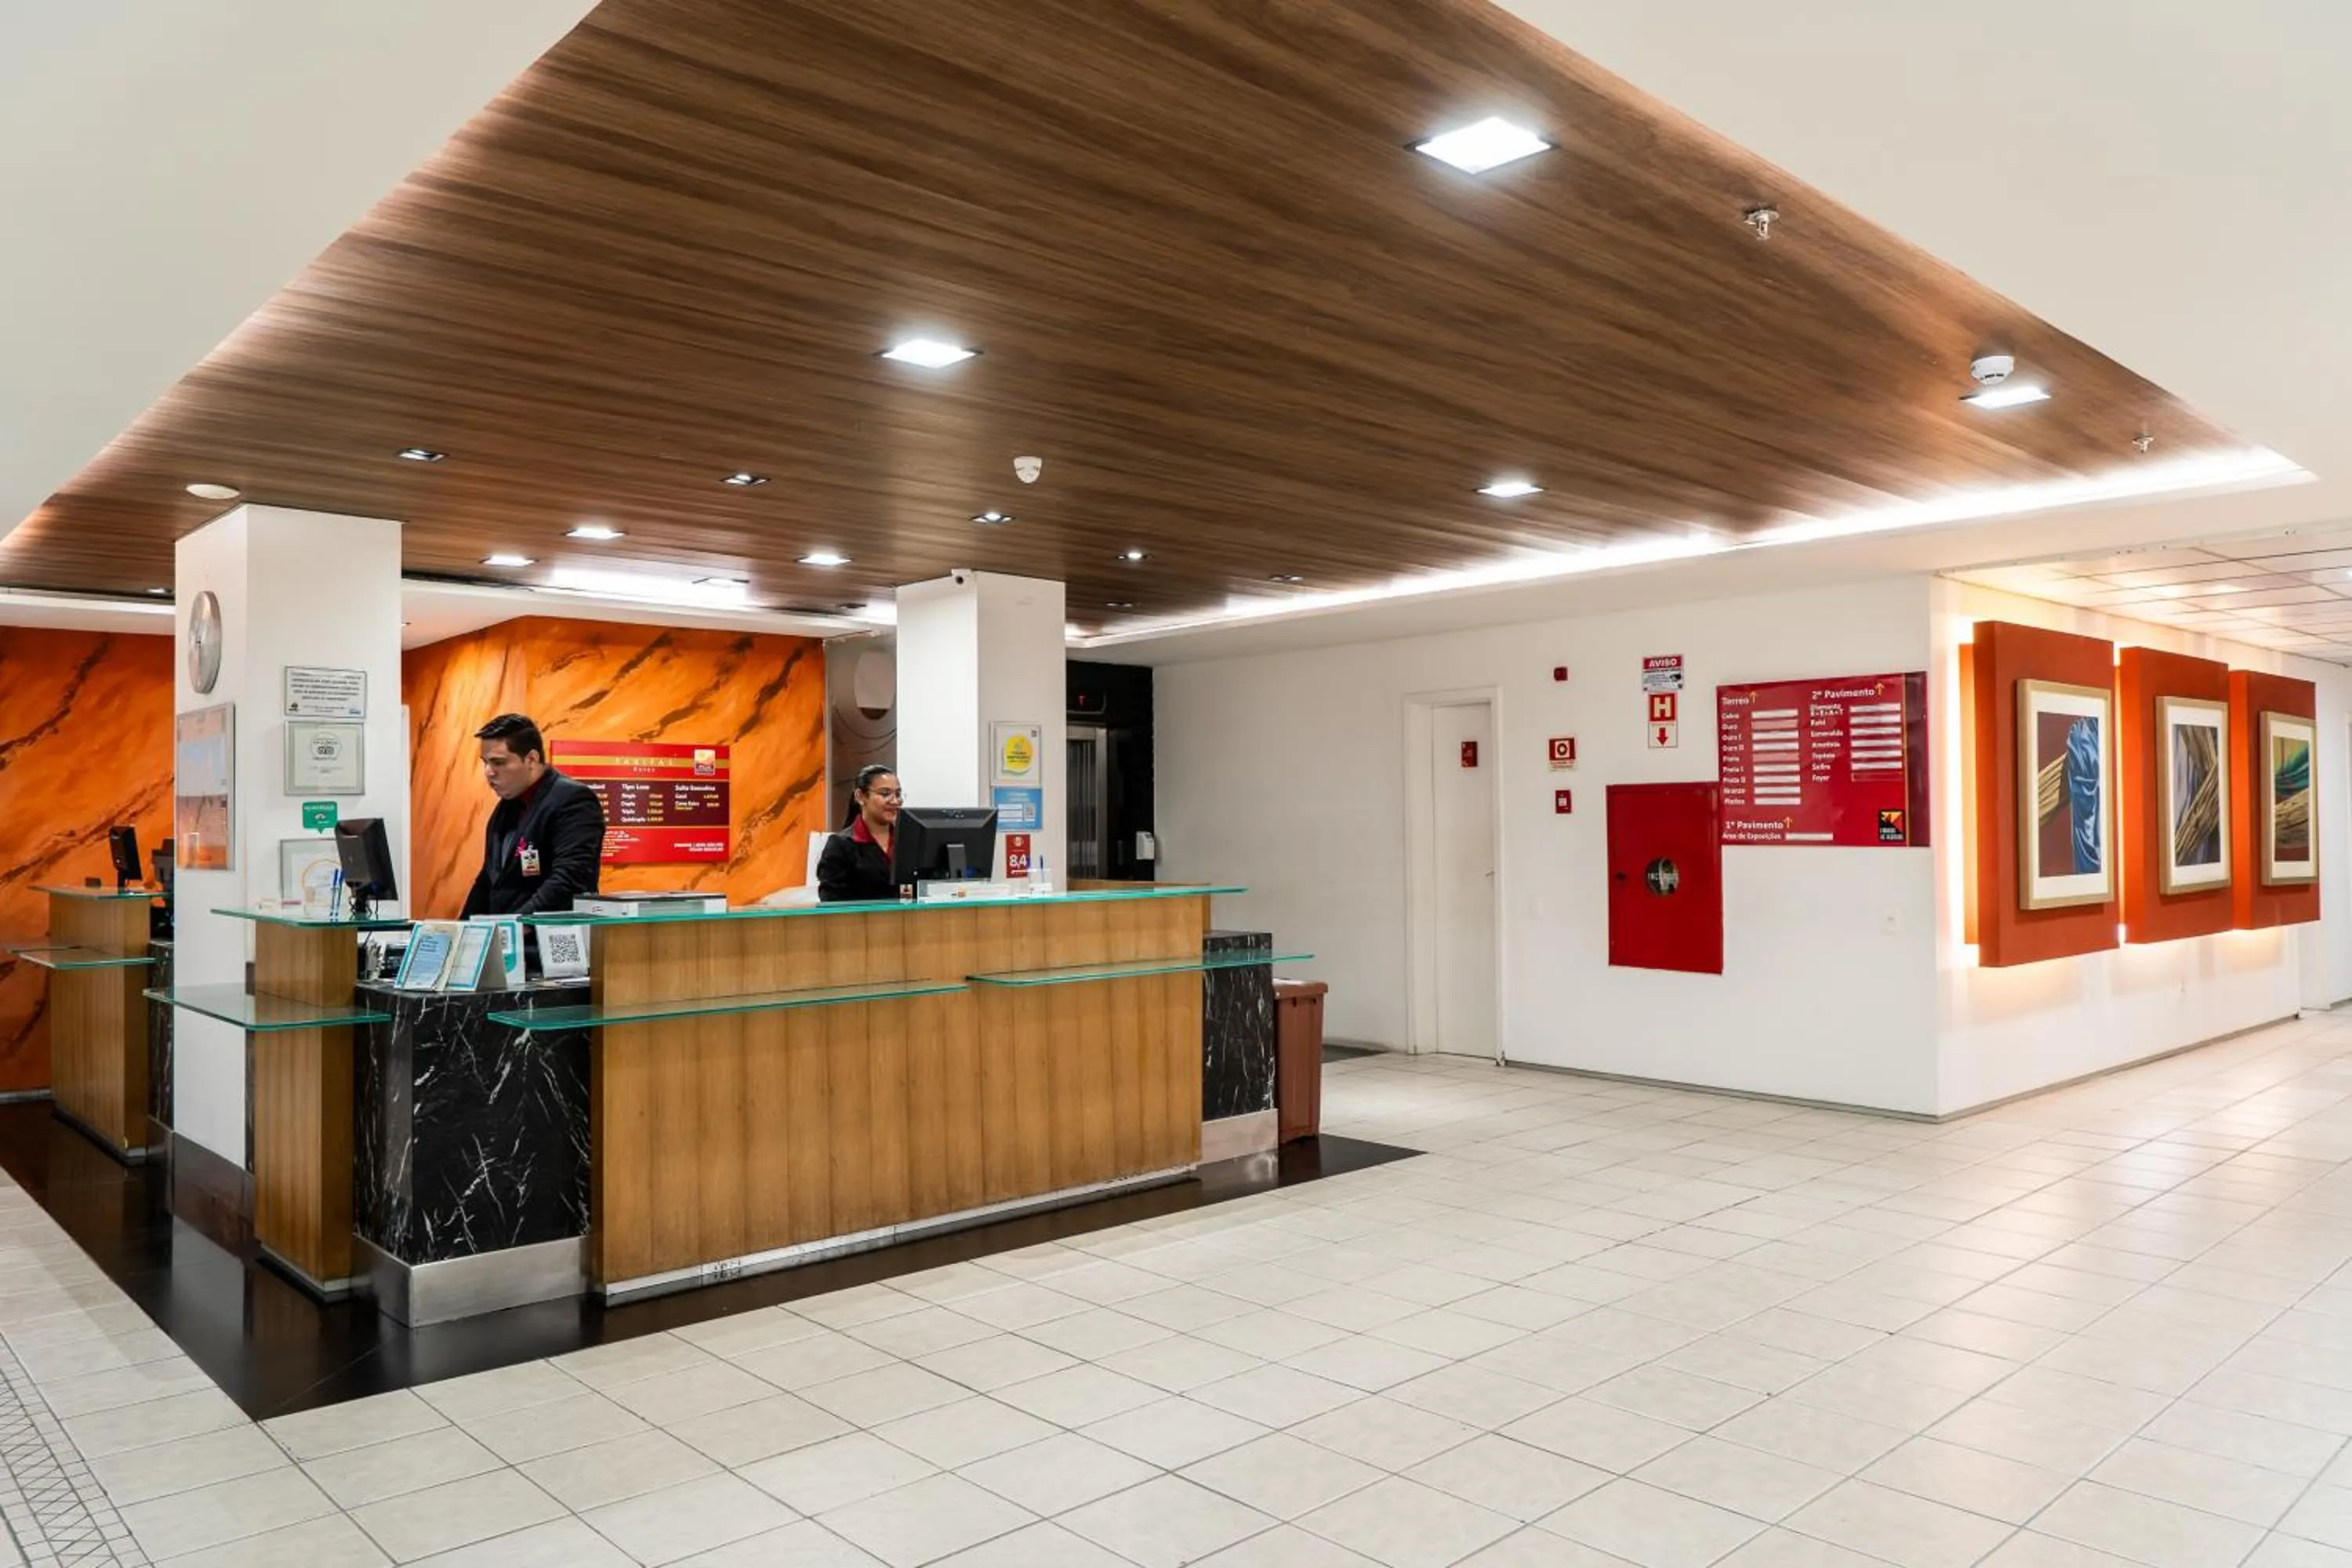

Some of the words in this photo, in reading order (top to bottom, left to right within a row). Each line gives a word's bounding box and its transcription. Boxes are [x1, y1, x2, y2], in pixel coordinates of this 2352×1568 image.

[1649, 658, 1678, 667] AVISO
[1824, 688, 1875, 699] Pavimento
[1653, 696, 1671, 718] H
[1737, 820, 1784, 829] Pavimento
